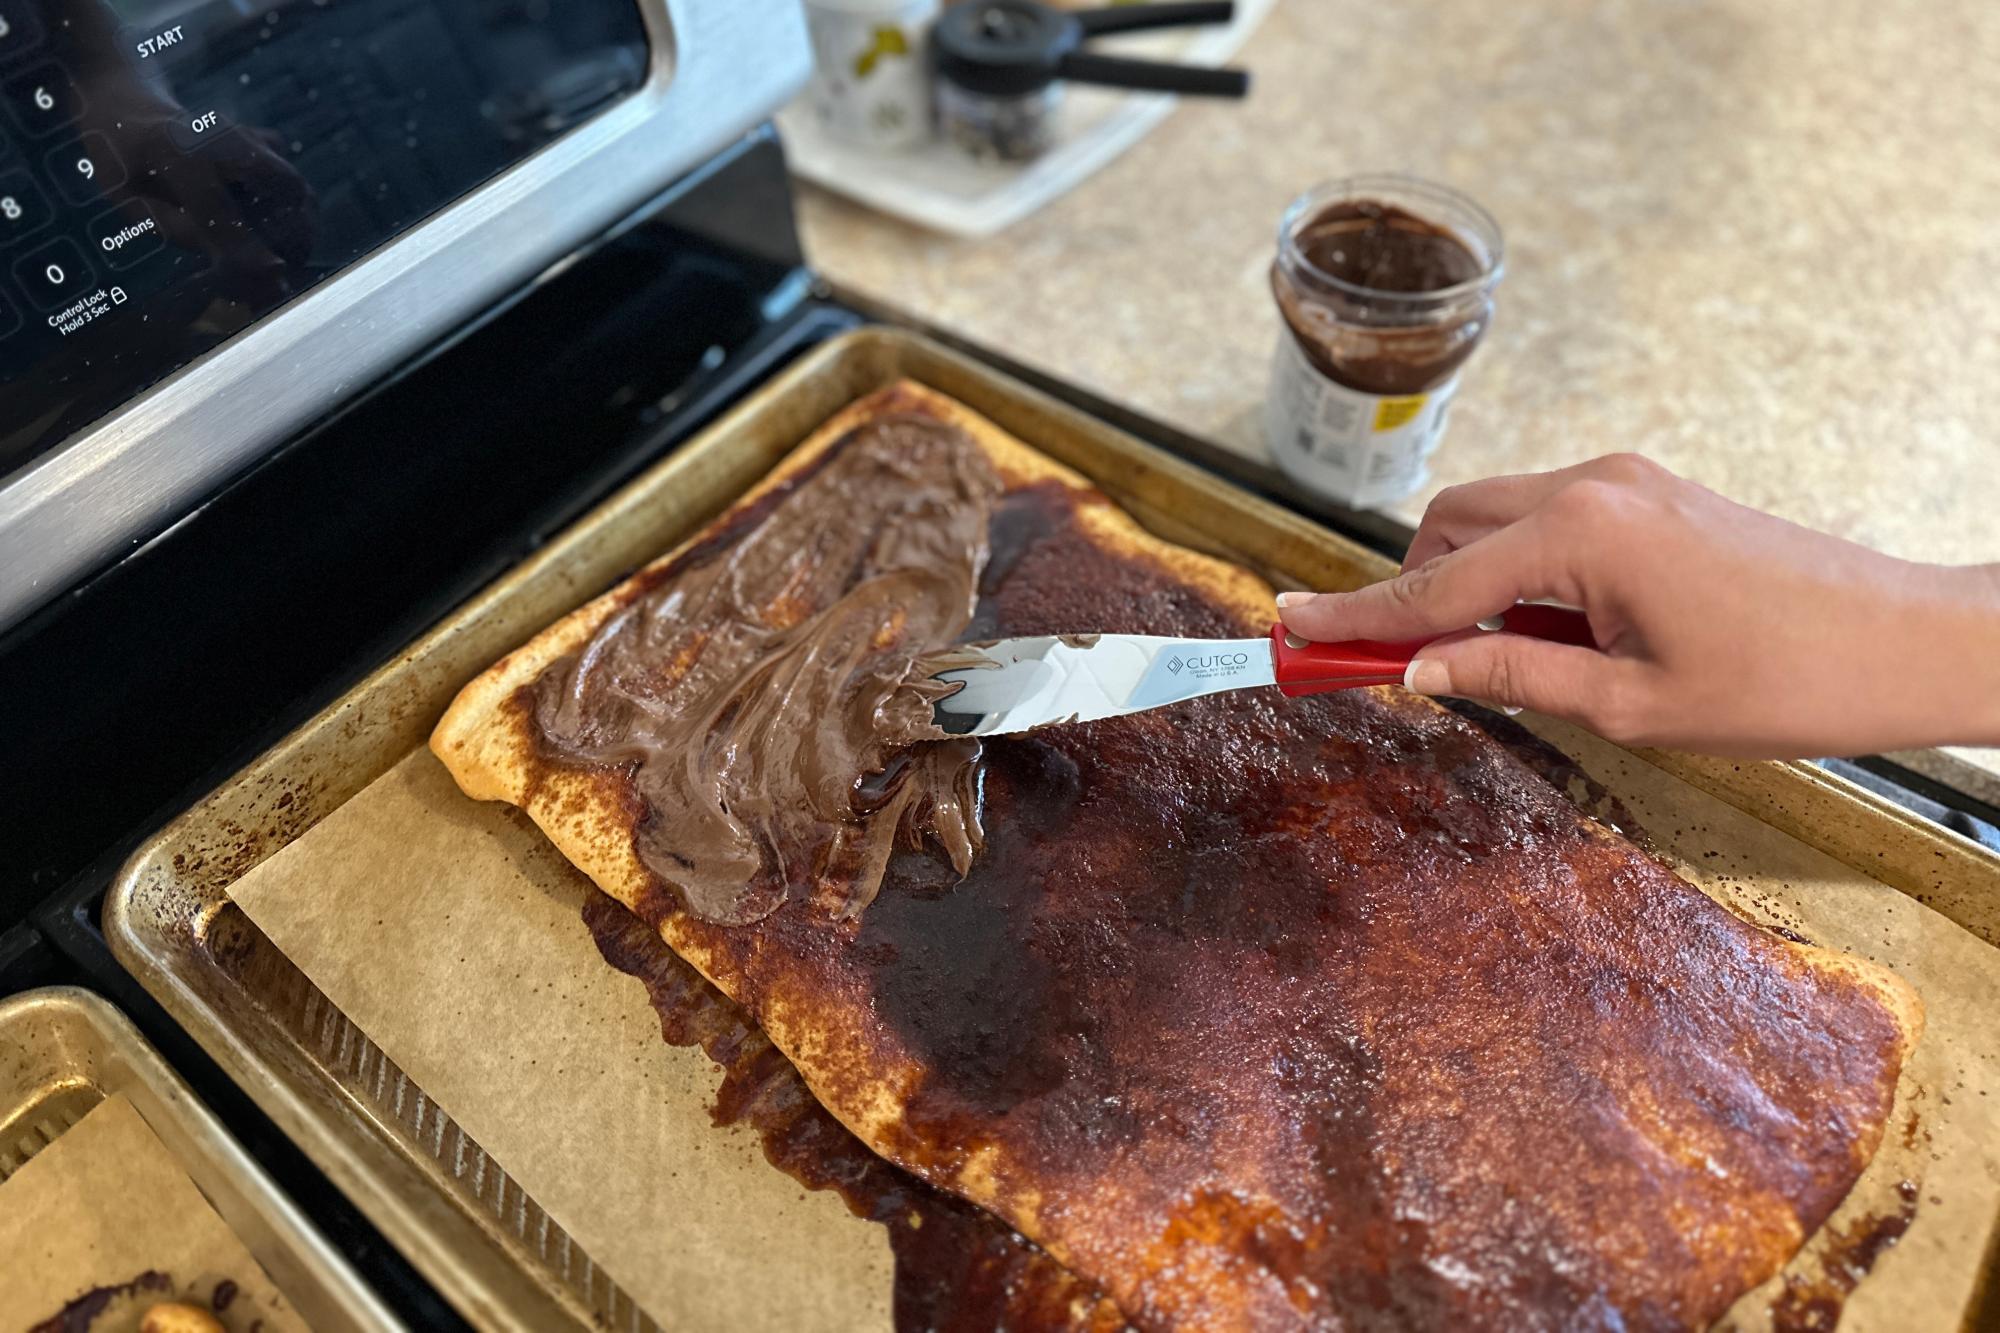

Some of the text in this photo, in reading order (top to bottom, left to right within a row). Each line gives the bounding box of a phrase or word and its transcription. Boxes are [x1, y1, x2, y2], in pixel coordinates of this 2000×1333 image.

[136, 25, 184, 58] START
[35, 87, 54, 110] 6
[191, 111, 218, 133] OFF
[77, 158, 94, 179] 9
[0, 197, 22, 219] 8
[101, 217, 155, 251] Options
[46, 264, 65, 284] 0
[48, 288, 108, 327] Control Lock
[59, 302, 111, 336] Hold 3 Sec
[1186, 653, 1247, 669] CUTCO
